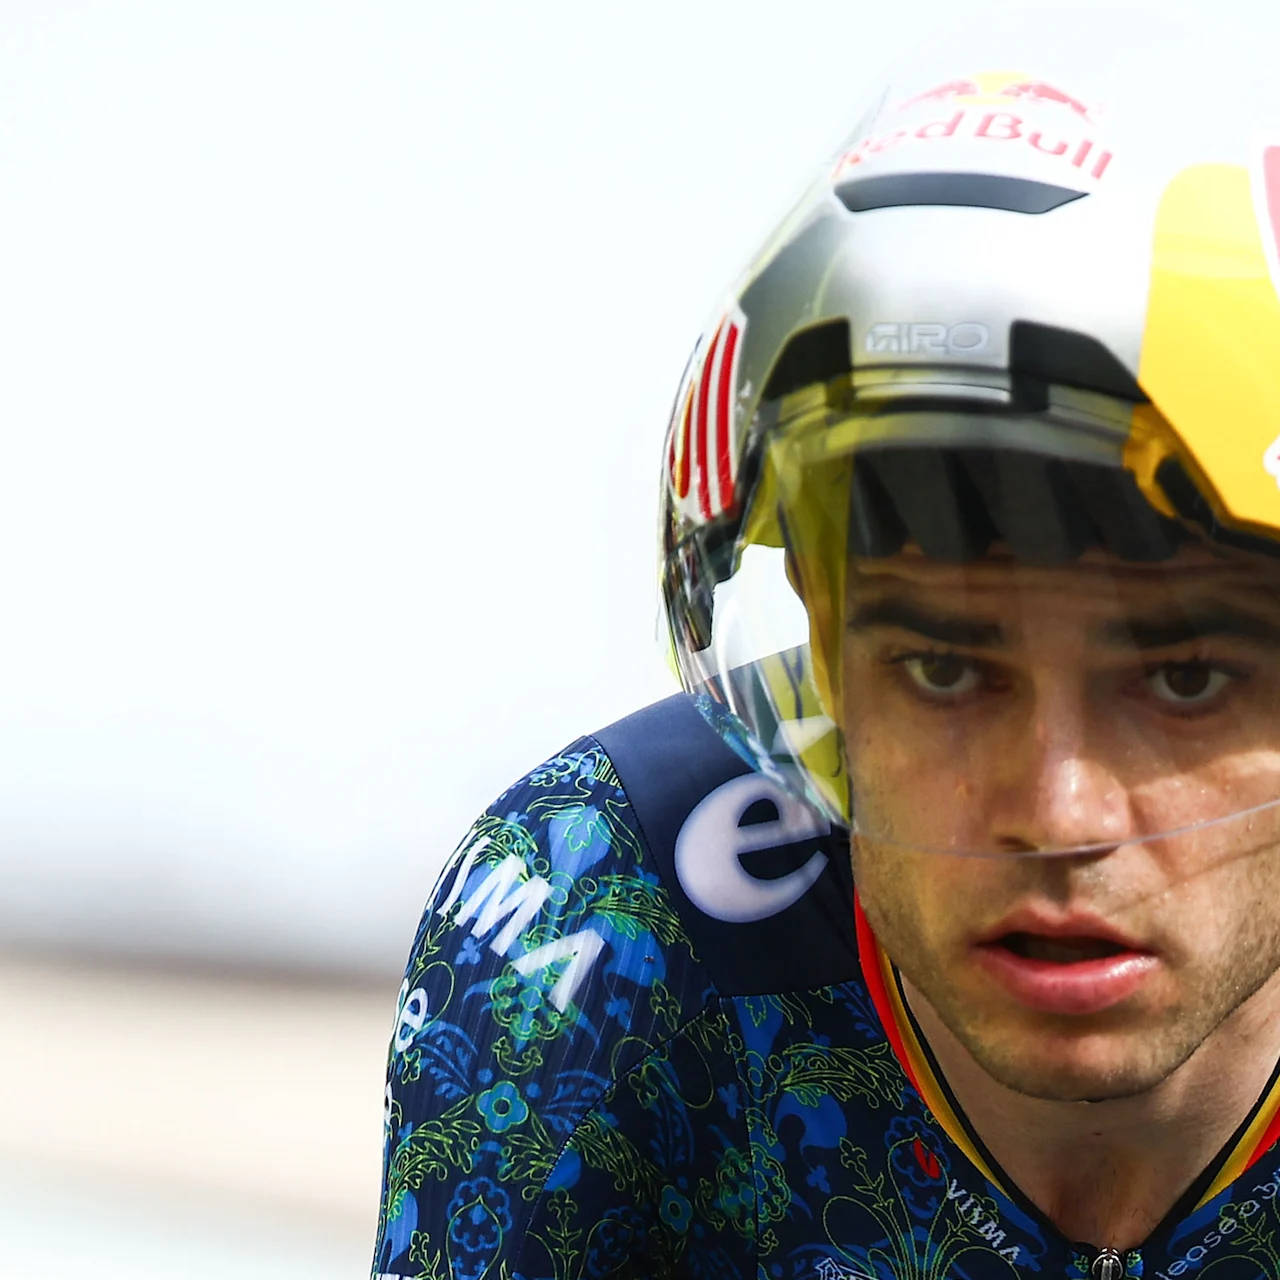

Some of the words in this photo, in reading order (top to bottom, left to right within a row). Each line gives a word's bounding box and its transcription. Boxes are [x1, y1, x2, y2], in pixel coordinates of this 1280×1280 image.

[973, 113, 1113, 180] Bull
[865, 322, 990, 355] GIRO
[948, 1179, 1021, 1264] VISMA
